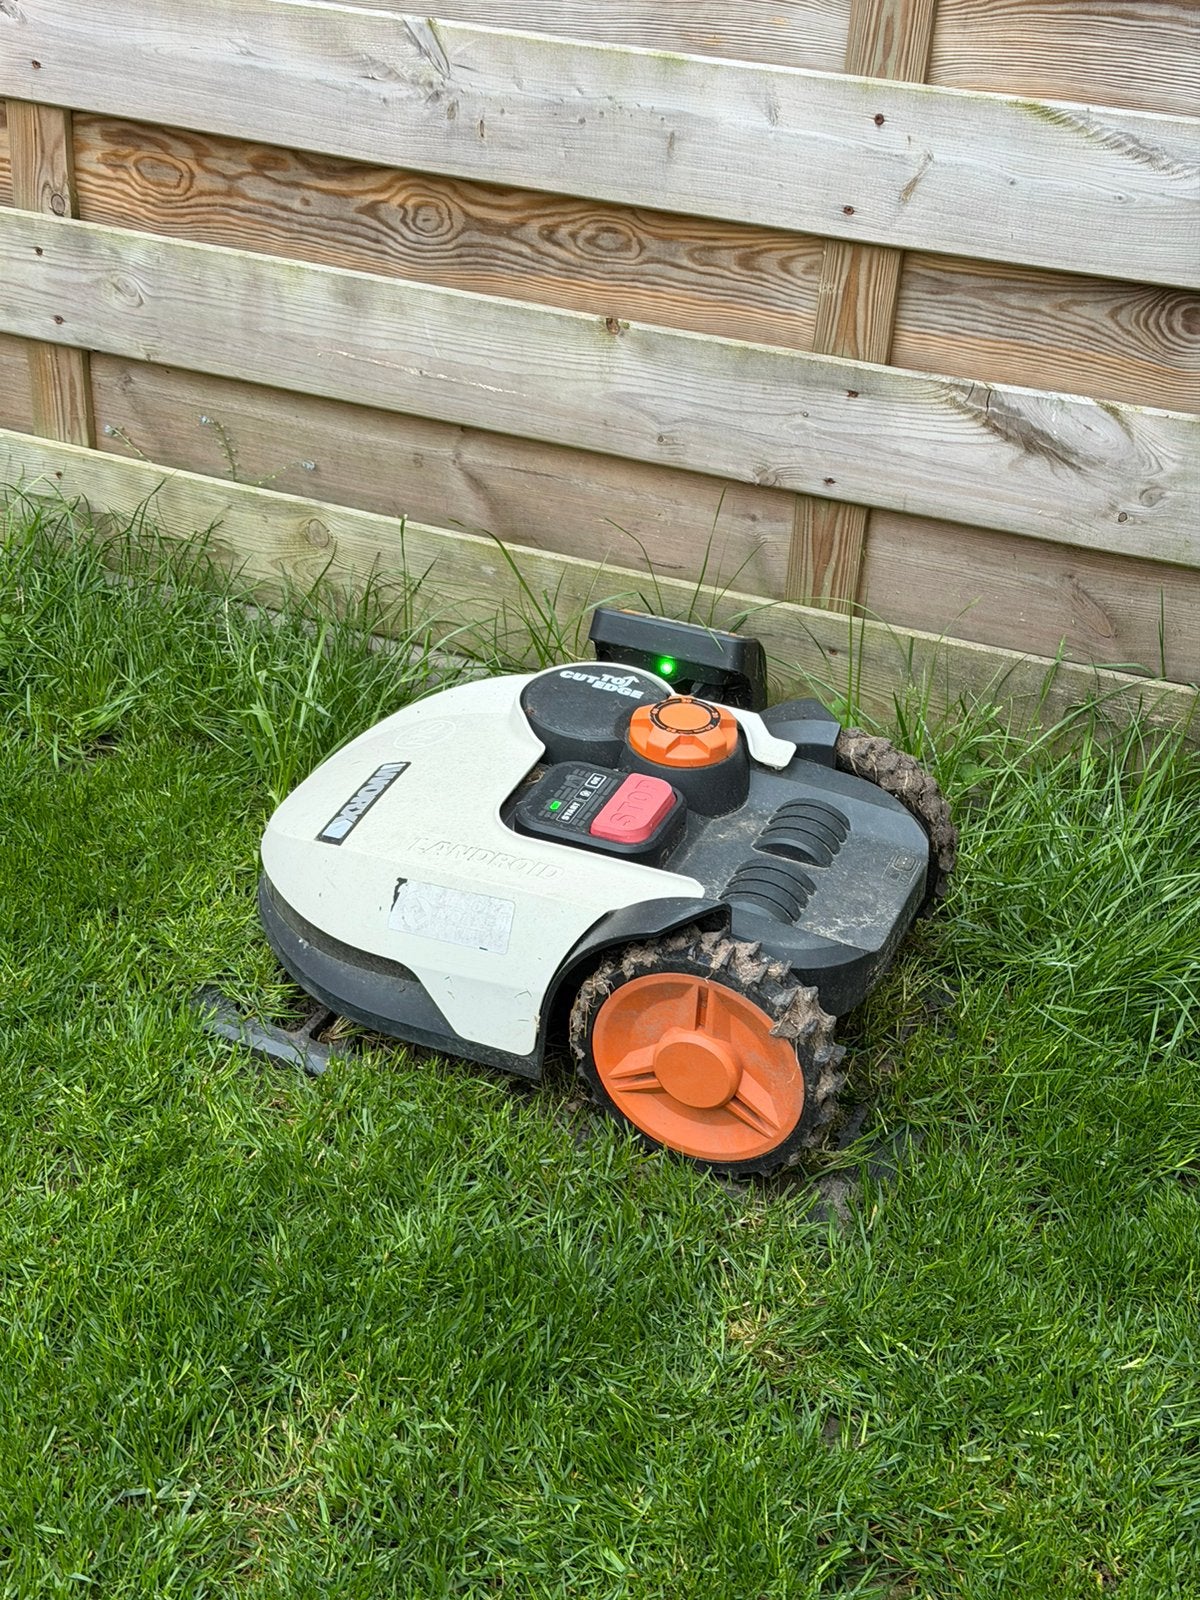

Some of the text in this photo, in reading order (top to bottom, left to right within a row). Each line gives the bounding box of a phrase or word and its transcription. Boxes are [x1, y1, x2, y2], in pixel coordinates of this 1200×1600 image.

[560, 670, 601, 684] CUT
[592, 681, 644, 699] EDGE
[322, 763, 407, 839] WORX
[561, 801, 580, 820] START
[610, 780, 657, 827] STOP
[407, 837, 565, 879] LANDROID
